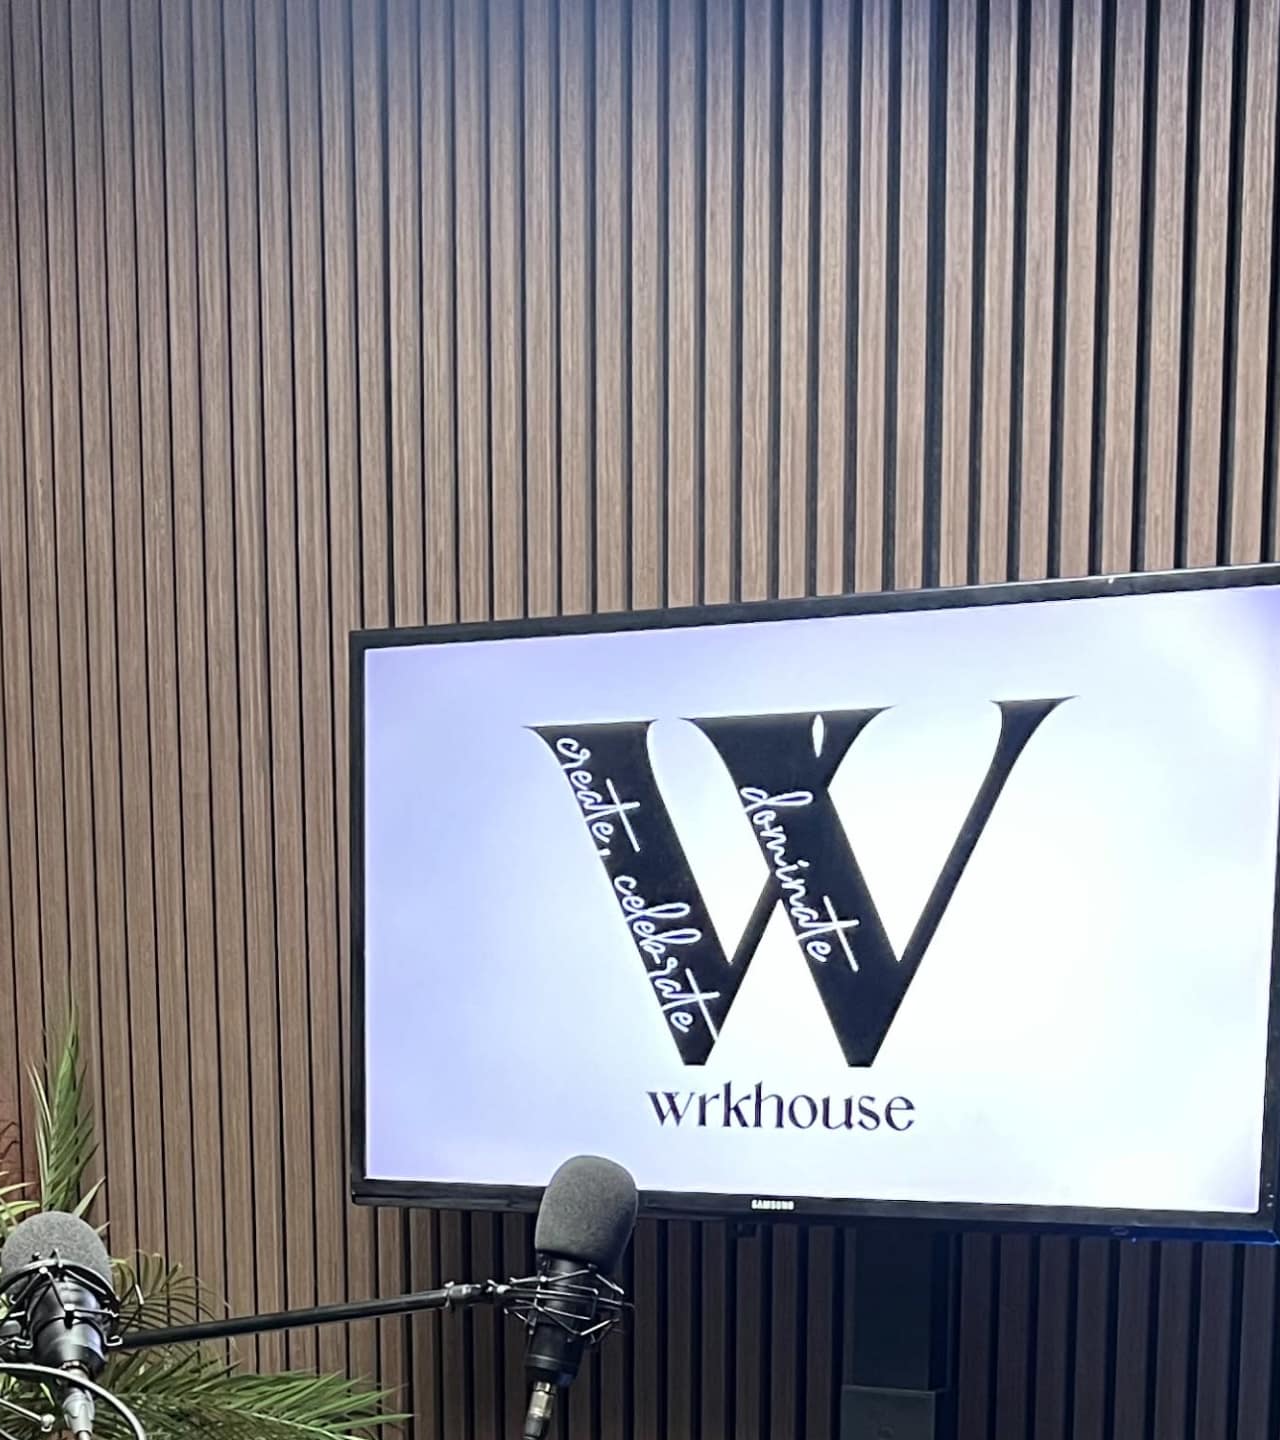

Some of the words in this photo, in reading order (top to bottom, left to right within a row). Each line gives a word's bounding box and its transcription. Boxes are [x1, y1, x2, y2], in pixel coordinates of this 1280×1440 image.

[523, 695, 1079, 1068] W
[613, 874, 720, 1041] celebrate
[739, 786, 860, 973] dominate
[646, 1080, 916, 1132] wrkhouse
